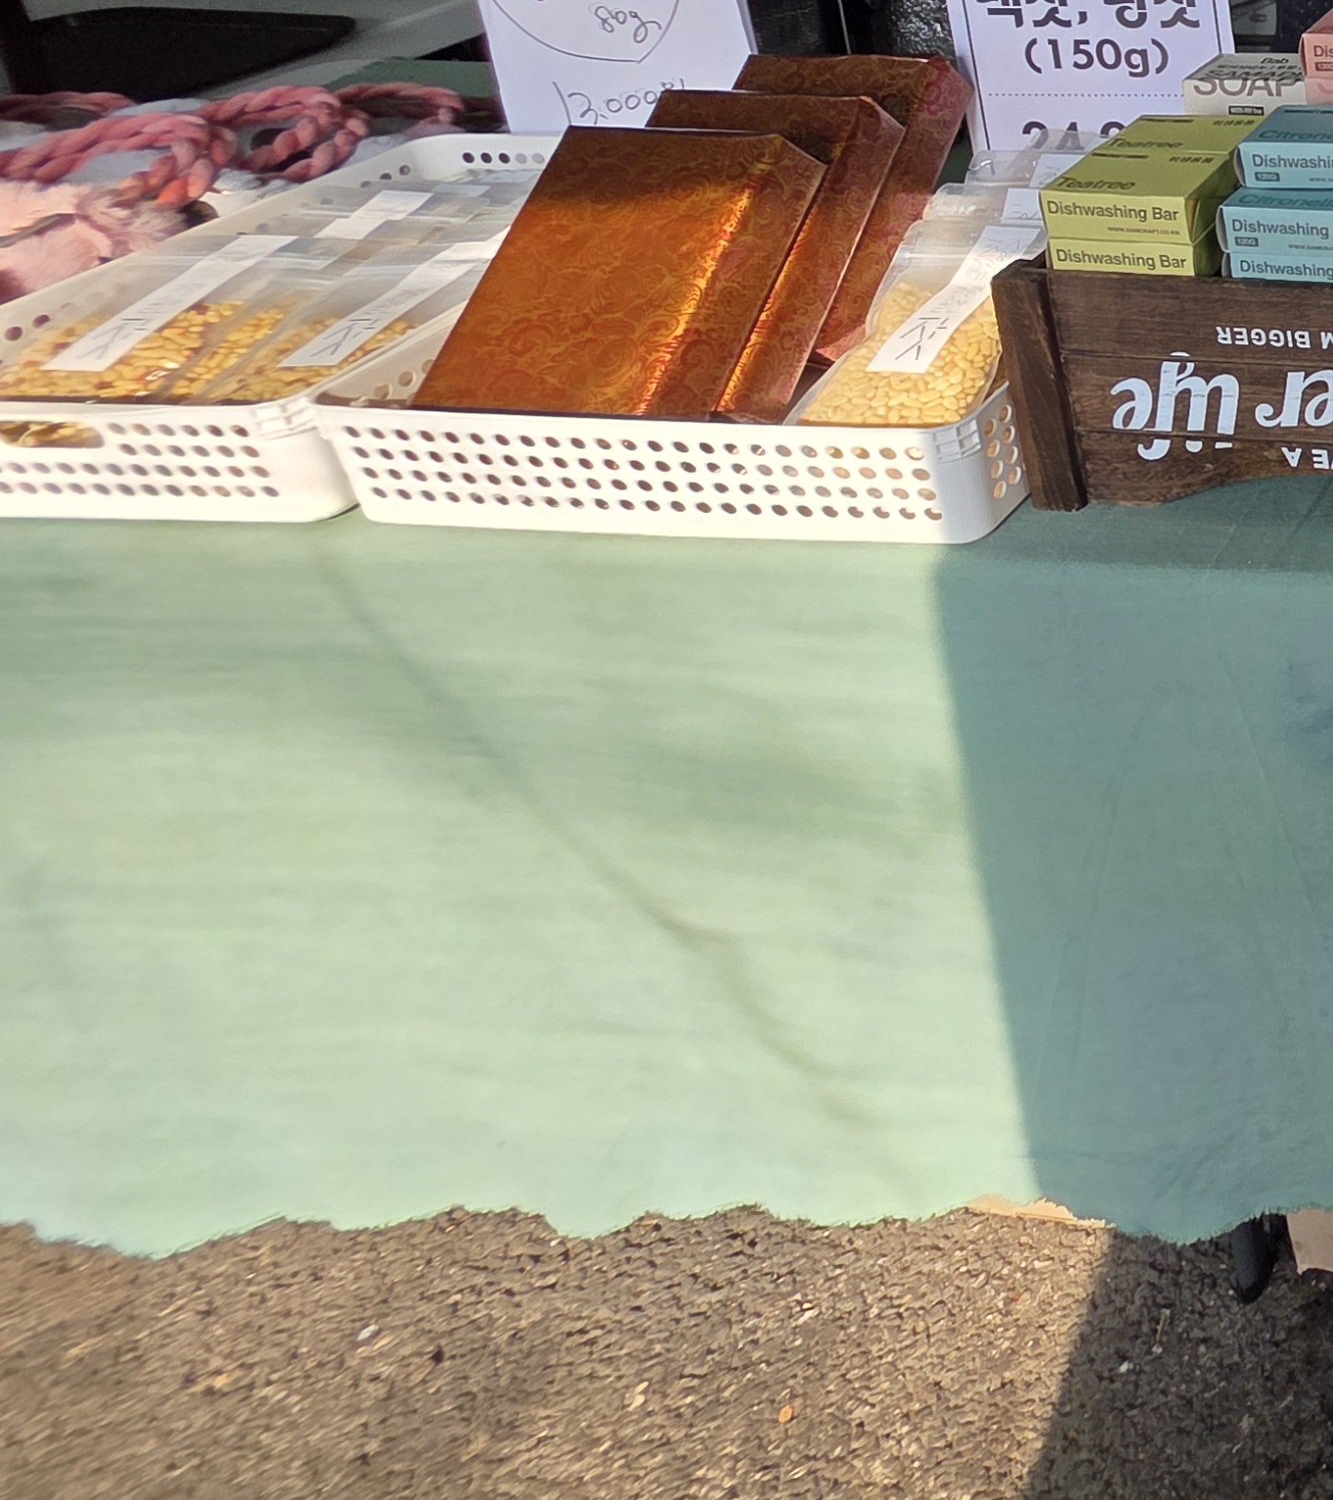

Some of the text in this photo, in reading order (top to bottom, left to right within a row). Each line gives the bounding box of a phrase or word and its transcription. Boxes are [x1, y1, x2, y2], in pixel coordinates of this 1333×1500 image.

[1024, 37, 1170, 78] (150g)
[1108, 137, 1183, 149] Teatree
[1055, 176, 1137, 191] Teatree
[1046, 199, 1180, 222] Dishwashing Bar
[1231, 218, 1330, 240] Dishwashing
[1056, 248, 1187, 271] Dishwashing Bar
[1214, 324, 1312, 350] BIGGER
[1281, 447, 1302, 469] A
